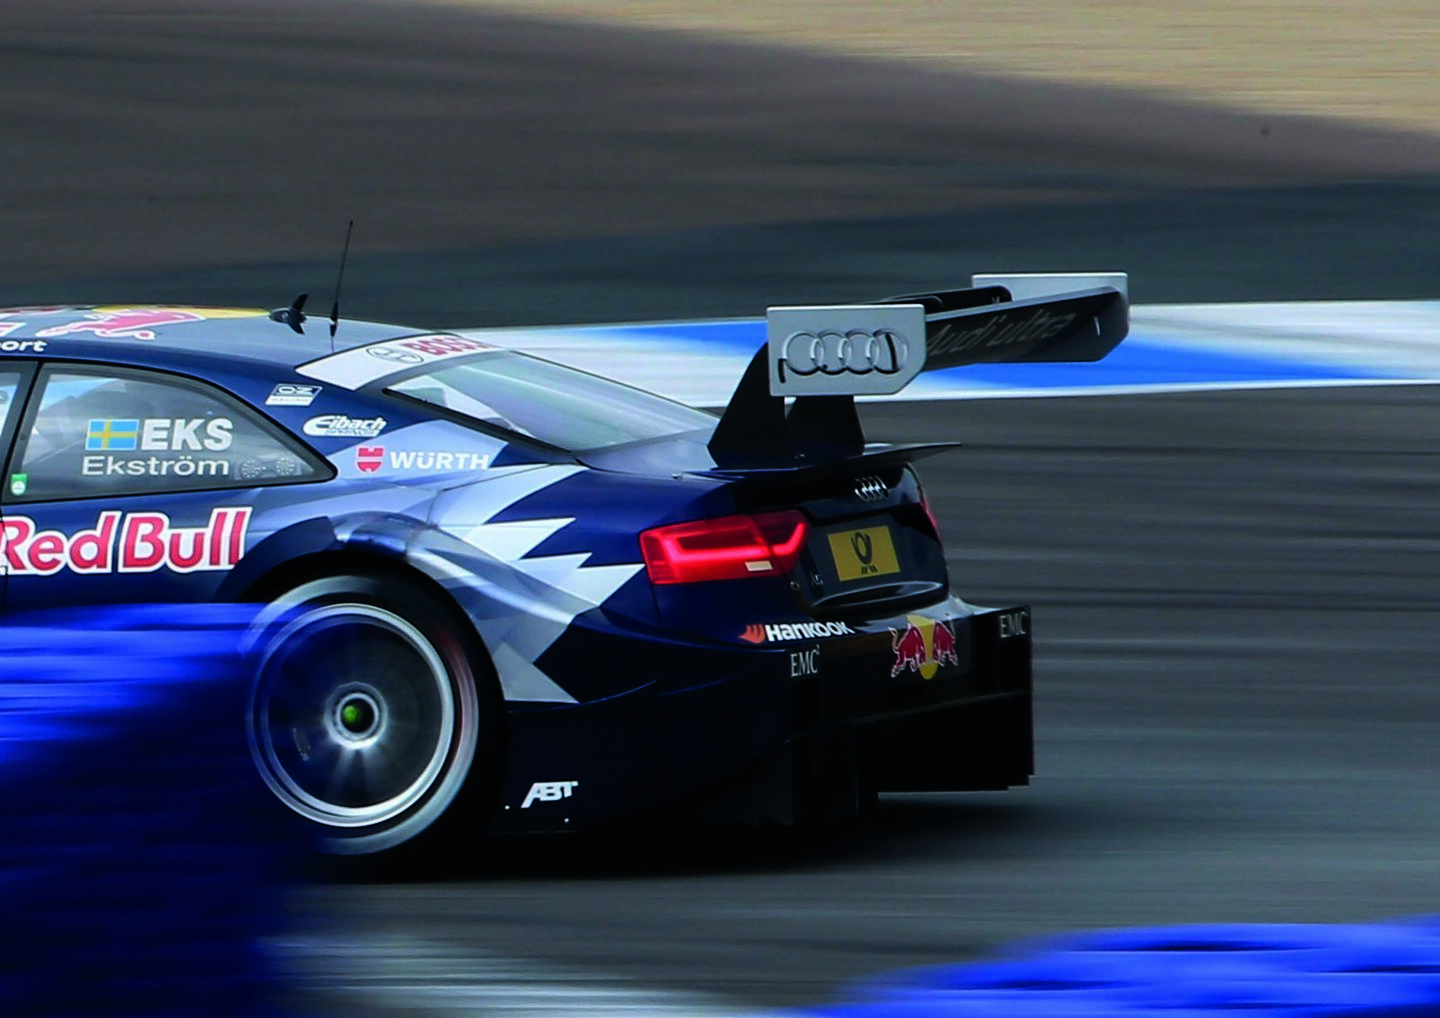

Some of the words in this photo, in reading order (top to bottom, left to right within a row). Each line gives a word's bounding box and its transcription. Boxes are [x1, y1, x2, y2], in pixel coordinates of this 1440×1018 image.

[141, 418, 233, 450] EKS
[303, 415, 388, 437] Eibach
[82, 456, 229, 476] Ekström
[117, 507, 253, 573] Bull
[521, 780, 579, 808] ABT
